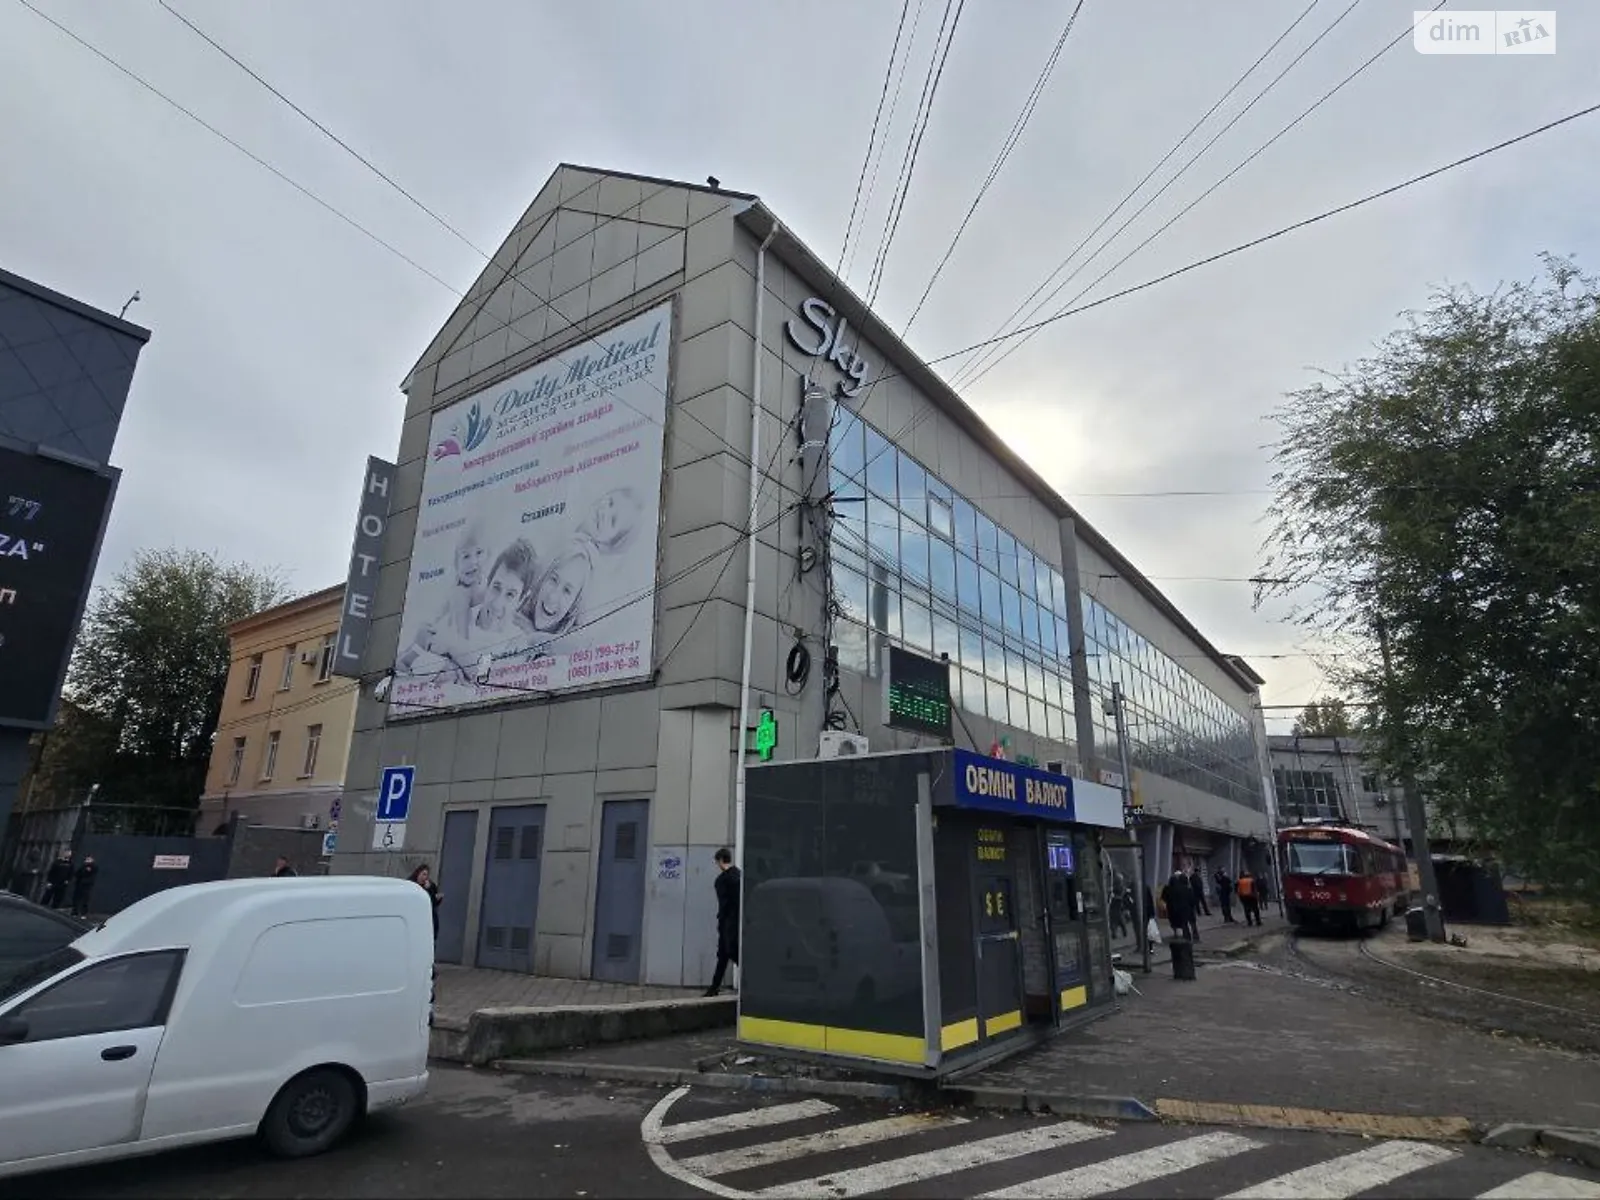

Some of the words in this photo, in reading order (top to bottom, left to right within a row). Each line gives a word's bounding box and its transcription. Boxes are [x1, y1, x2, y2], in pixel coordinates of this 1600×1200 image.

[493, 374, 561, 416] Daily
[563, 320, 662, 386] Medical
[786, 297, 869, 397] Sky
[9, 495, 42, 520] 77
[342, 472, 389, 660] HOTEL
[384, 772, 406, 815] P
[966, 764, 1016, 801] ОБМІН
[1025, 778, 1067, 810] ВАЛЮТ
